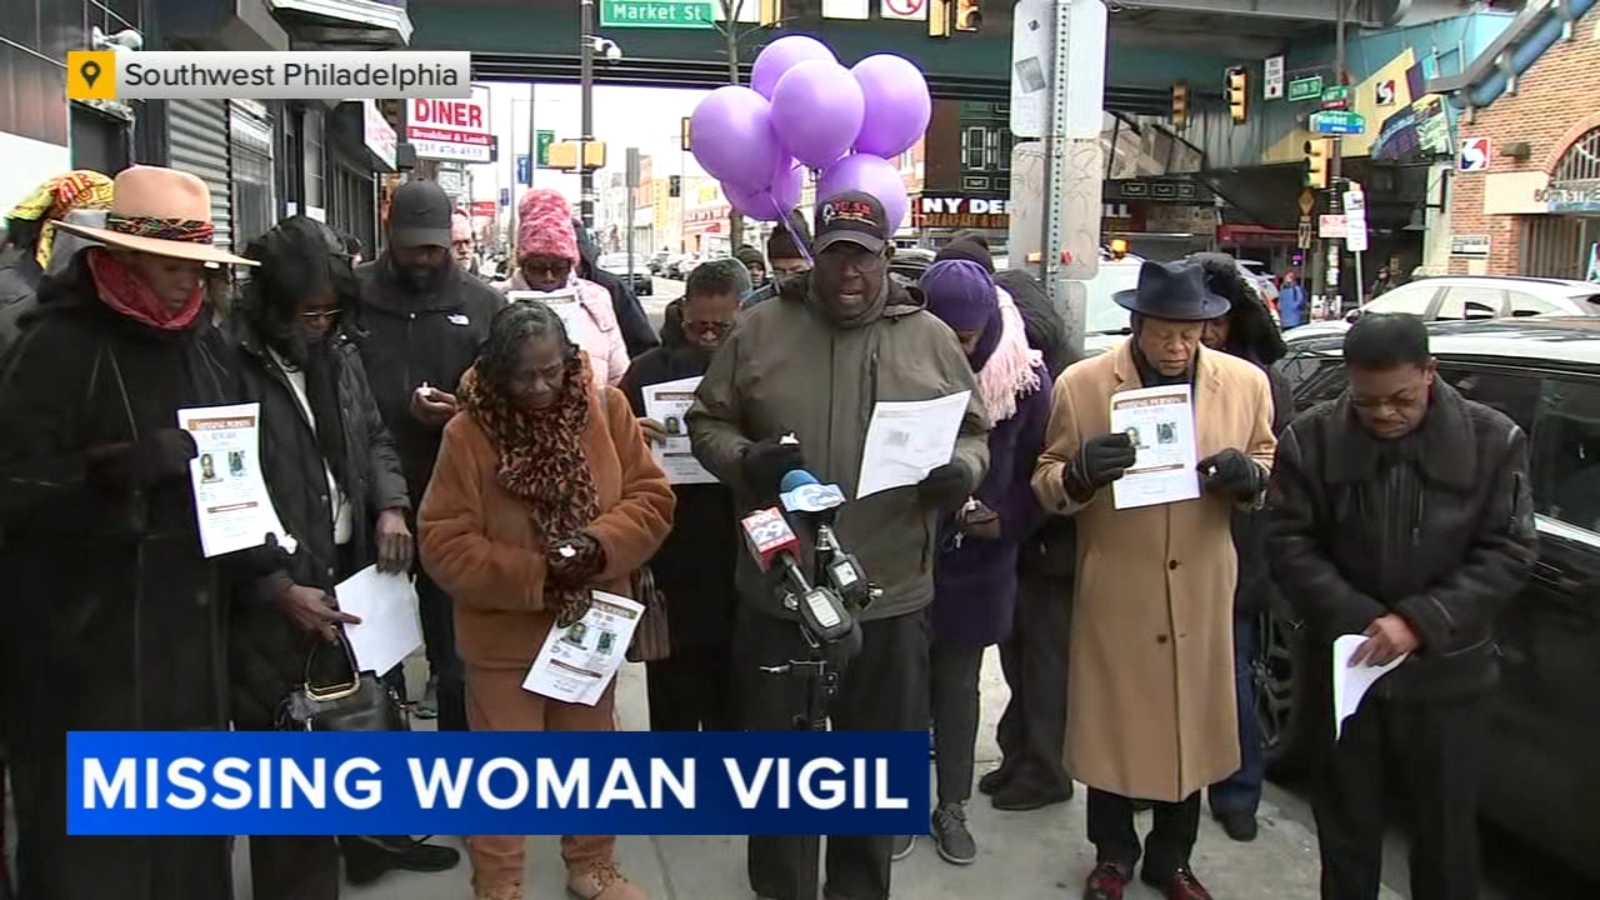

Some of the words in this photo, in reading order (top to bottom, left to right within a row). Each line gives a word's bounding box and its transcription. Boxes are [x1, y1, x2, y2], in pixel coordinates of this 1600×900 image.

[613, 3, 676, 20] Market
[684, 5, 701, 20] St
[414, 97, 482, 128] DINER
[922, 199, 962, 214] NY
[751, 521, 785, 544] 29
